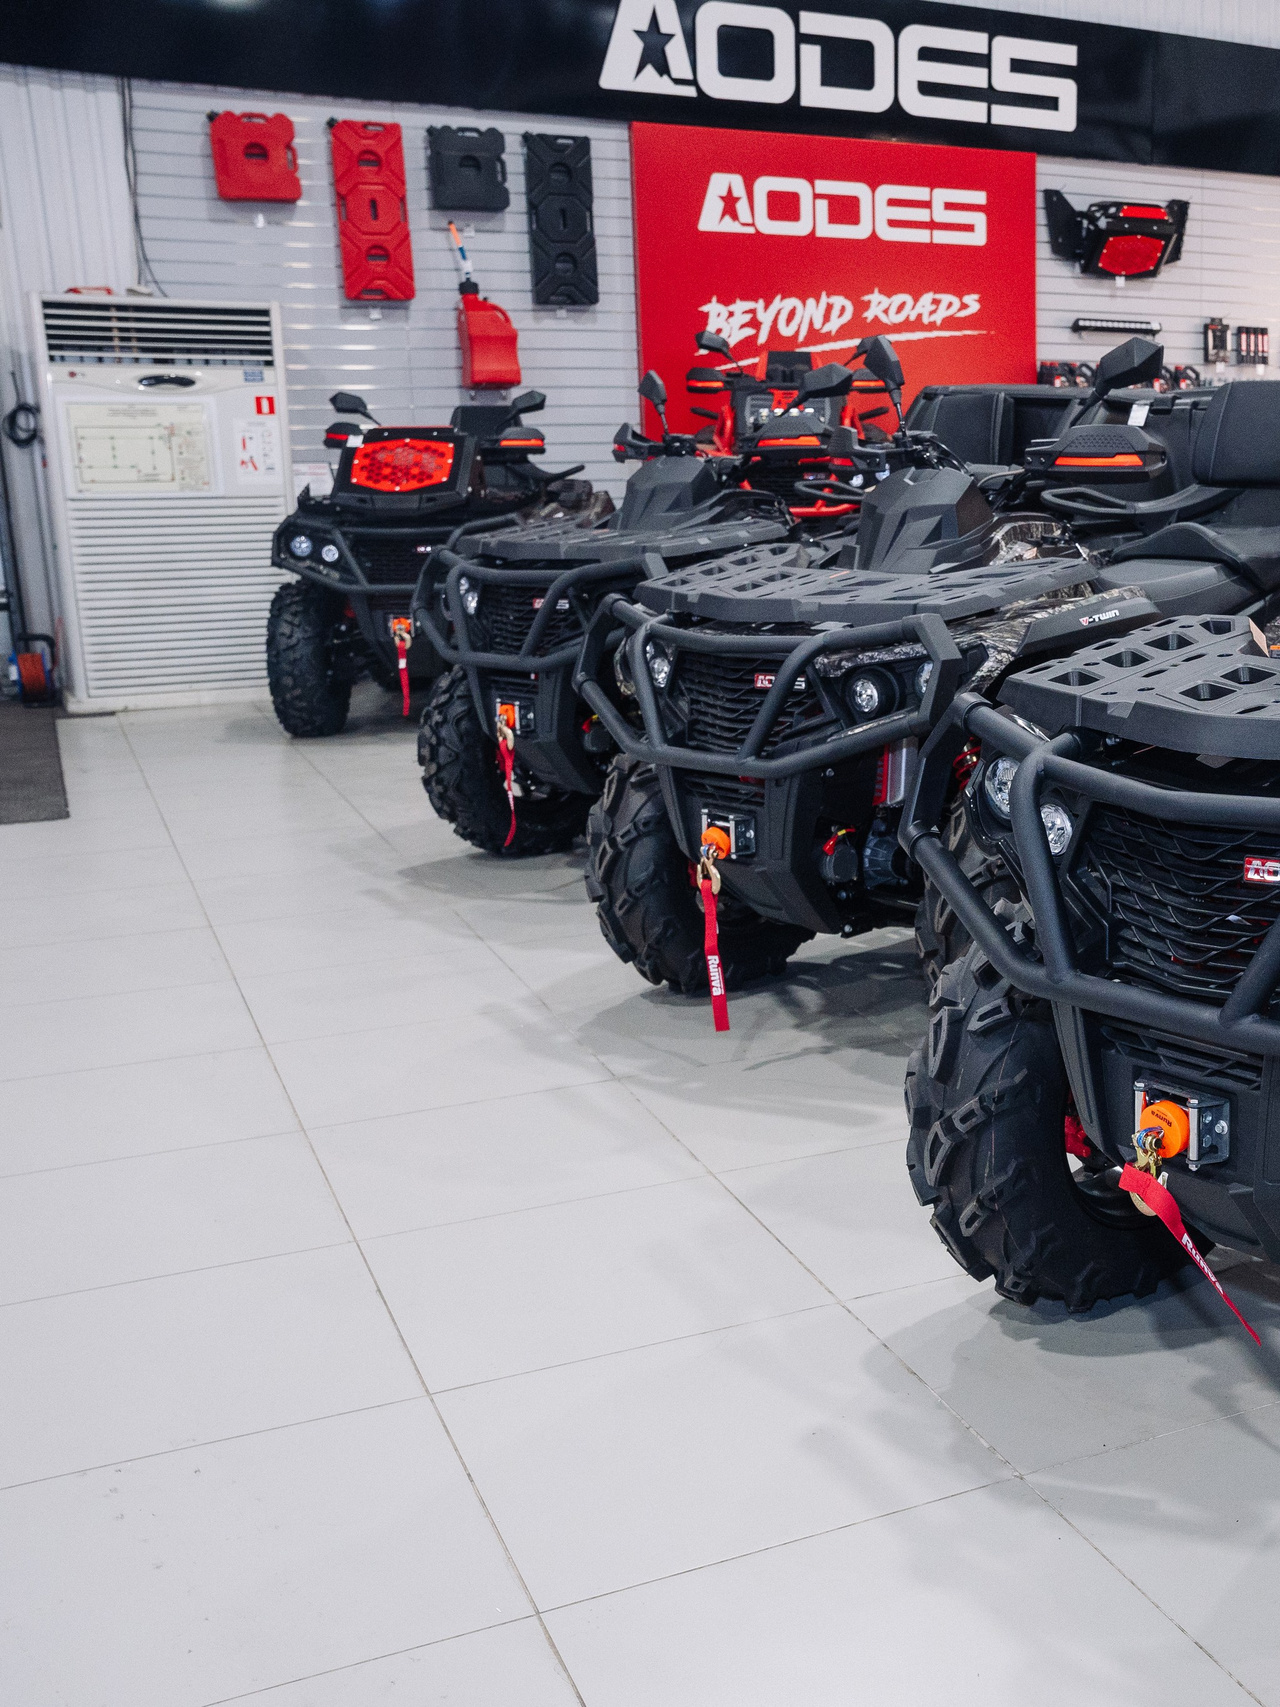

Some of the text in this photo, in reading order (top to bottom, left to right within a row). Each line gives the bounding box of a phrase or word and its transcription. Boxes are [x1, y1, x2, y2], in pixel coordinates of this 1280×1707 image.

[599, 0, 1078, 133] AODES
[697, 172, 988, 247] AODES
[698, 287, 981, 347] BEYOND ROADS
[707, 955, 723, 996] Runva
